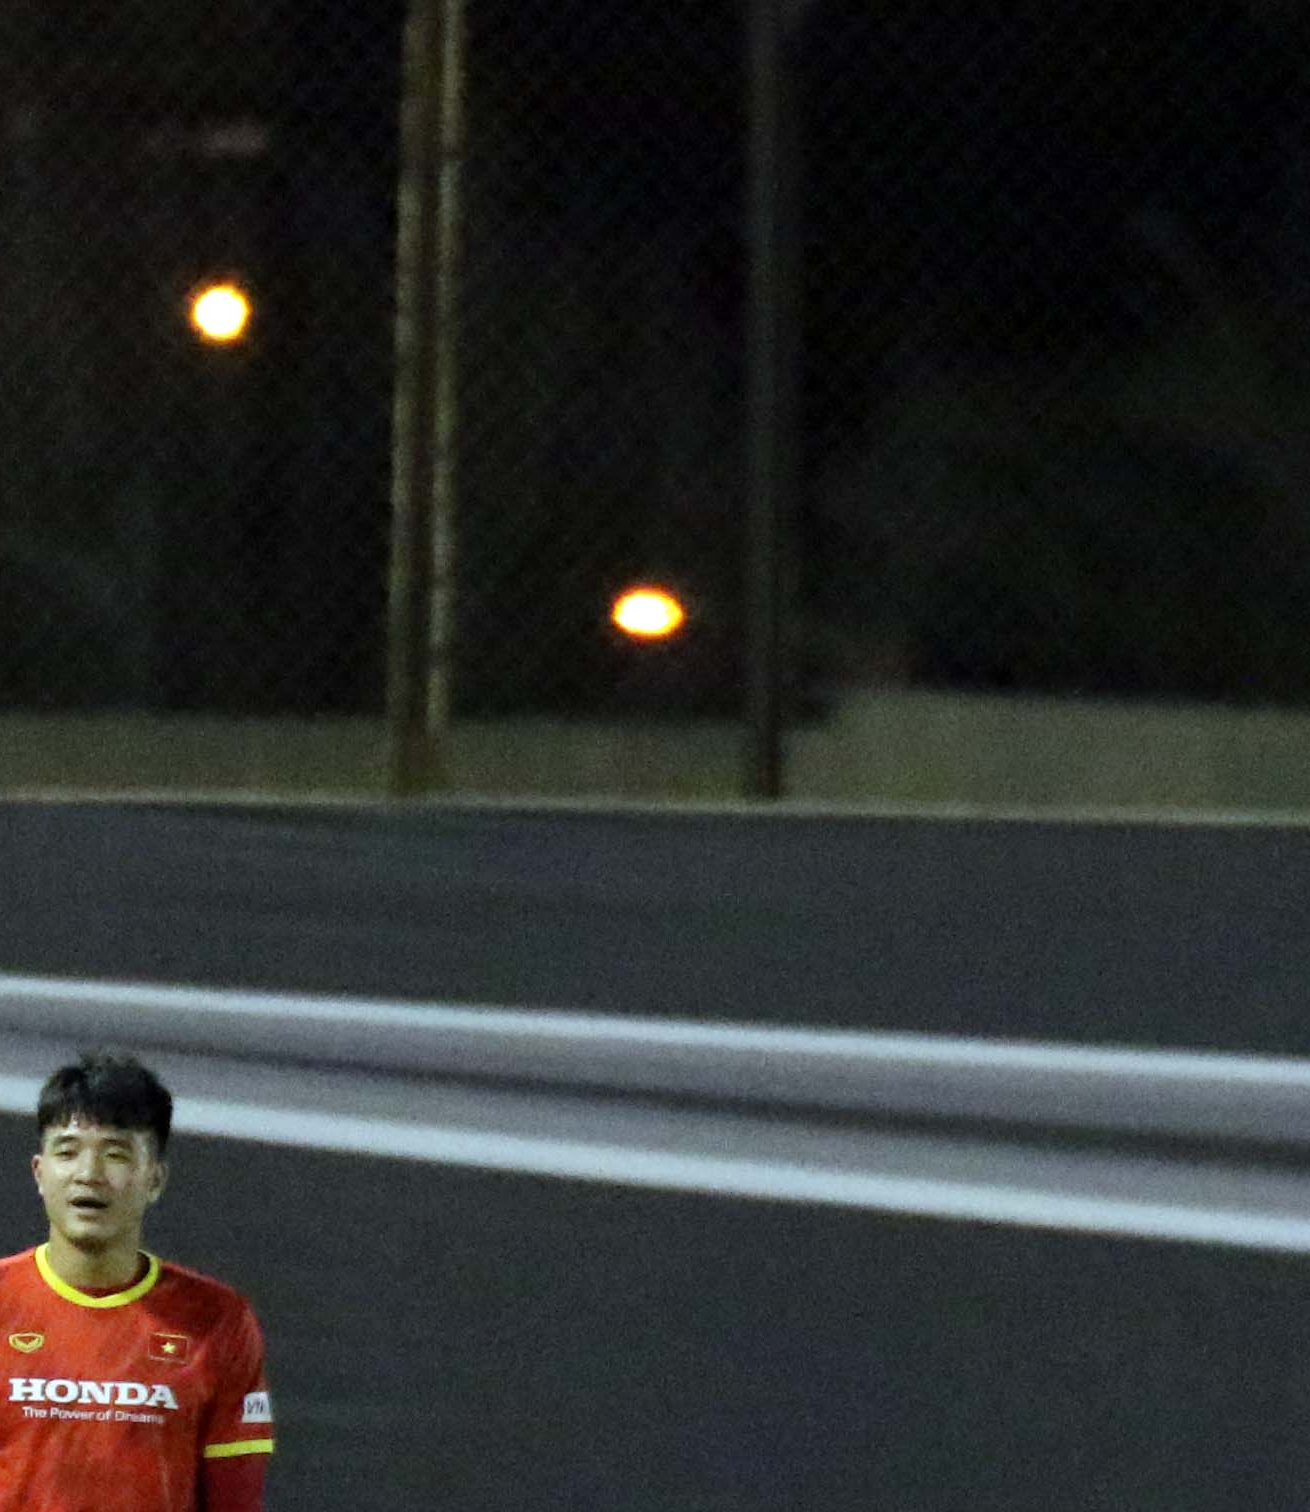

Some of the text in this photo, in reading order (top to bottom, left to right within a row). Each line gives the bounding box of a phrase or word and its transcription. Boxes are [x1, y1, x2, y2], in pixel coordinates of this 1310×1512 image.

[8, 1376, 179, 1409] HONDA
[22, 1405, 165, 1424] The Power of Dreams
